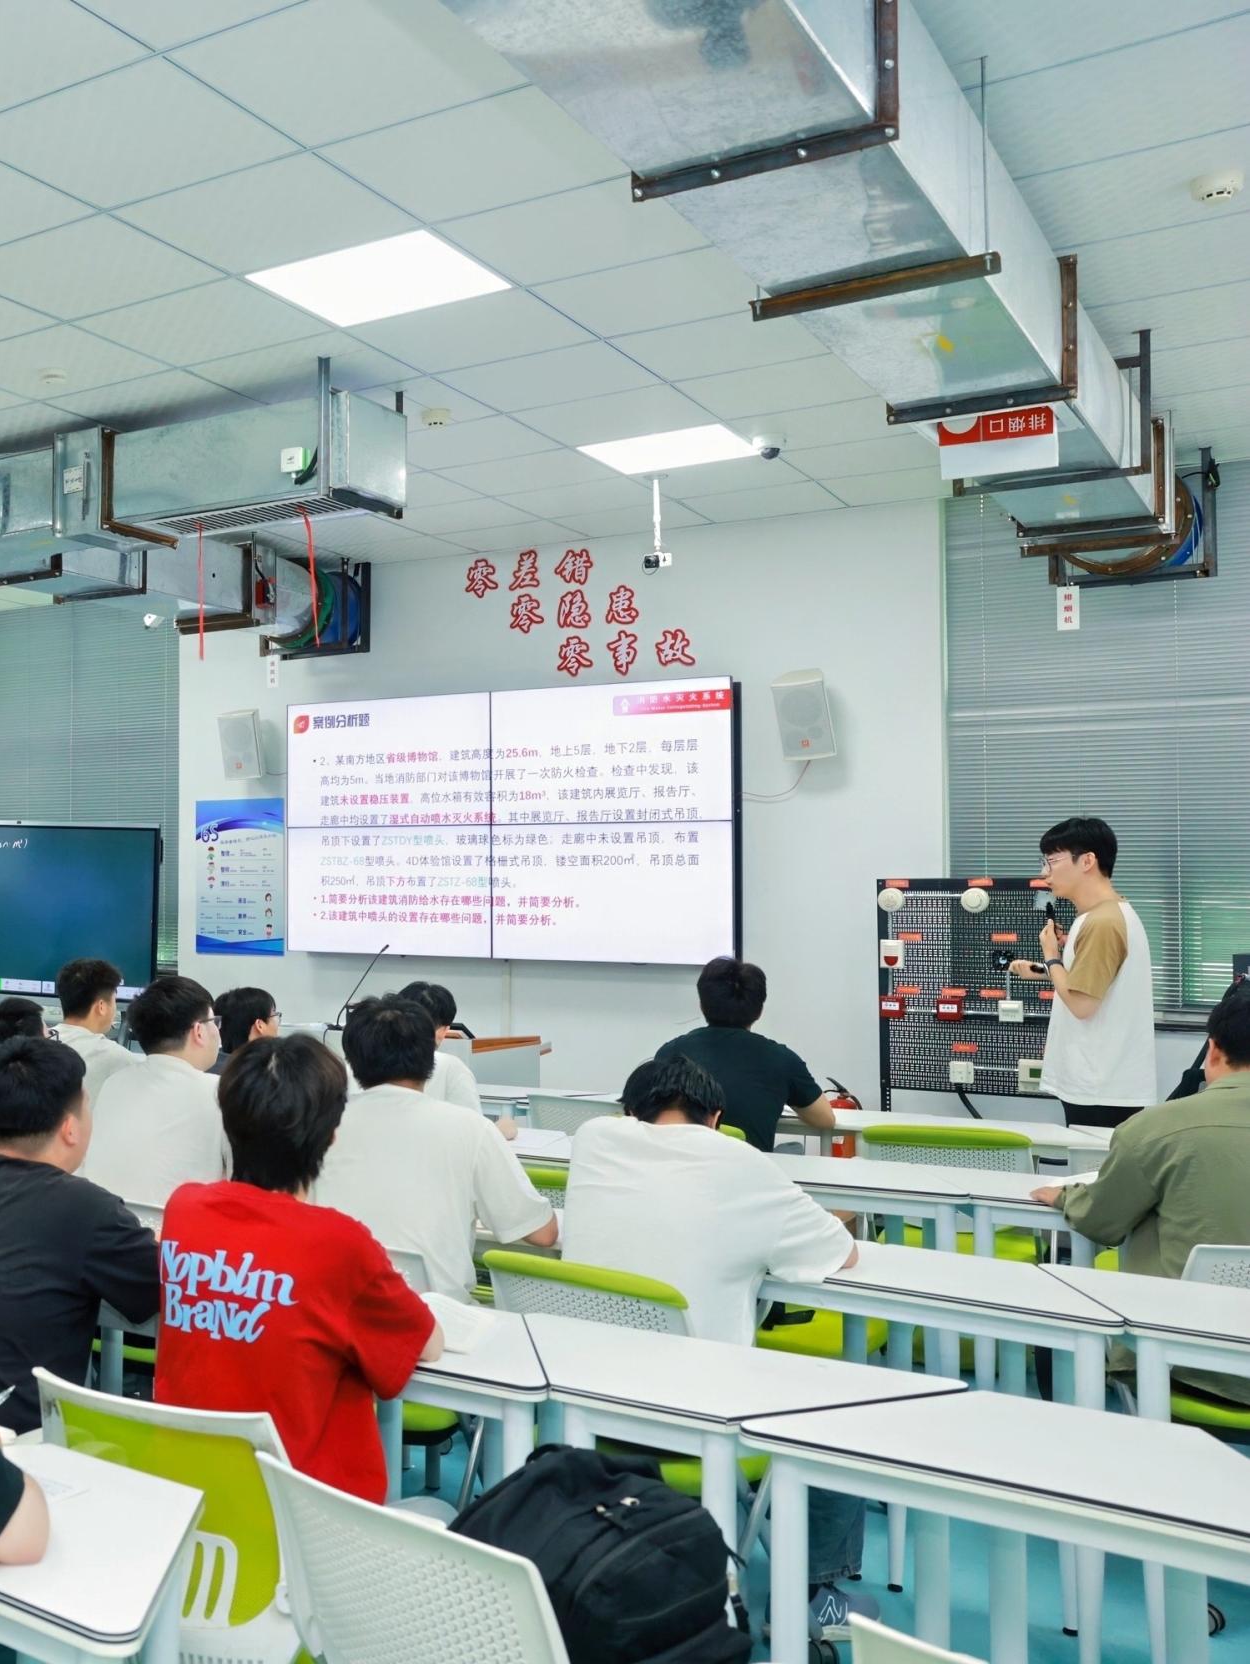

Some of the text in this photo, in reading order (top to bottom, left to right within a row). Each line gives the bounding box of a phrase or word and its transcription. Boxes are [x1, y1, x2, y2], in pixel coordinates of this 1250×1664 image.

[510, 585, 639, 633] 零隐患
[557, 629, 696, 676] 零事故
[312, 713, 370, 730] 案例分析题
